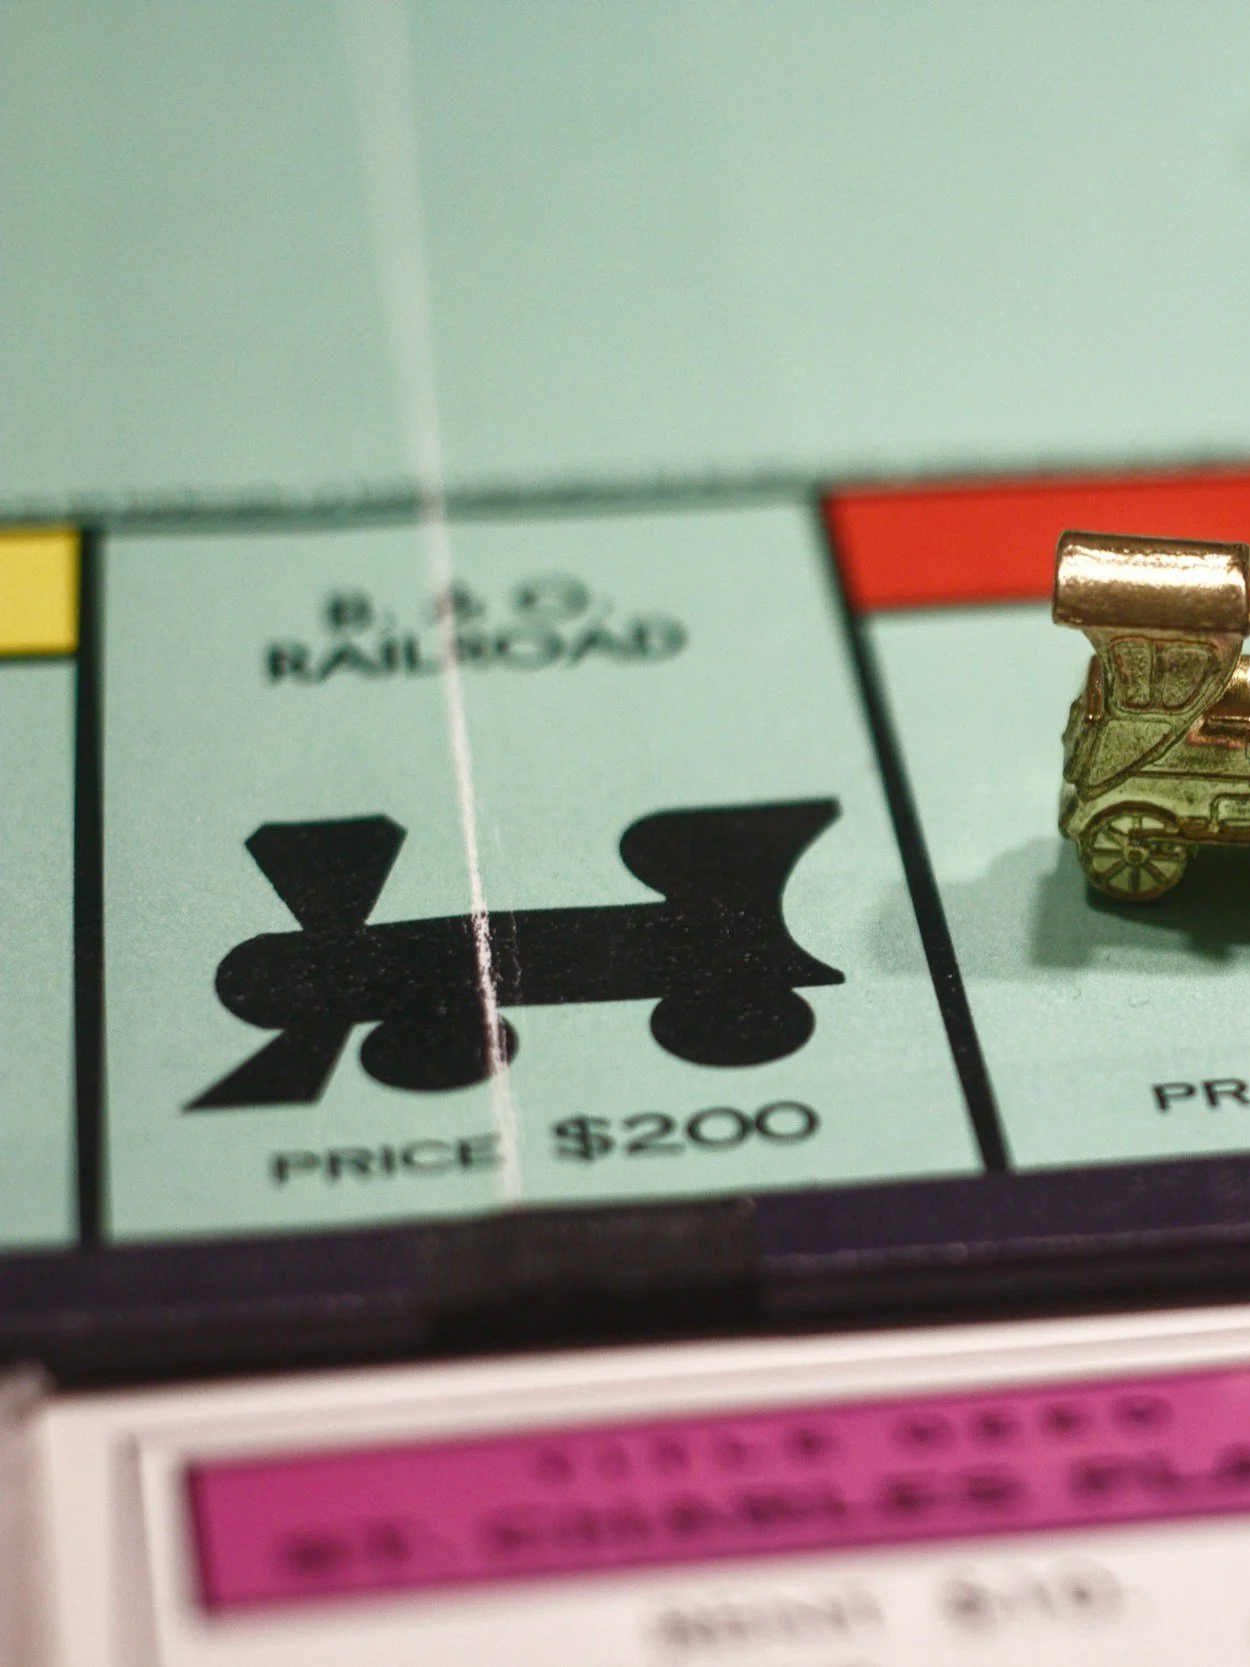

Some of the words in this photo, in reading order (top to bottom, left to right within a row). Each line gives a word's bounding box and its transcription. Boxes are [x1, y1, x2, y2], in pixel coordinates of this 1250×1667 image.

[266, 612, 689, 686] RAILROAD
[270, 1135, 505, 1186] PRICE
[552, 1099, 820, 1163] $200
